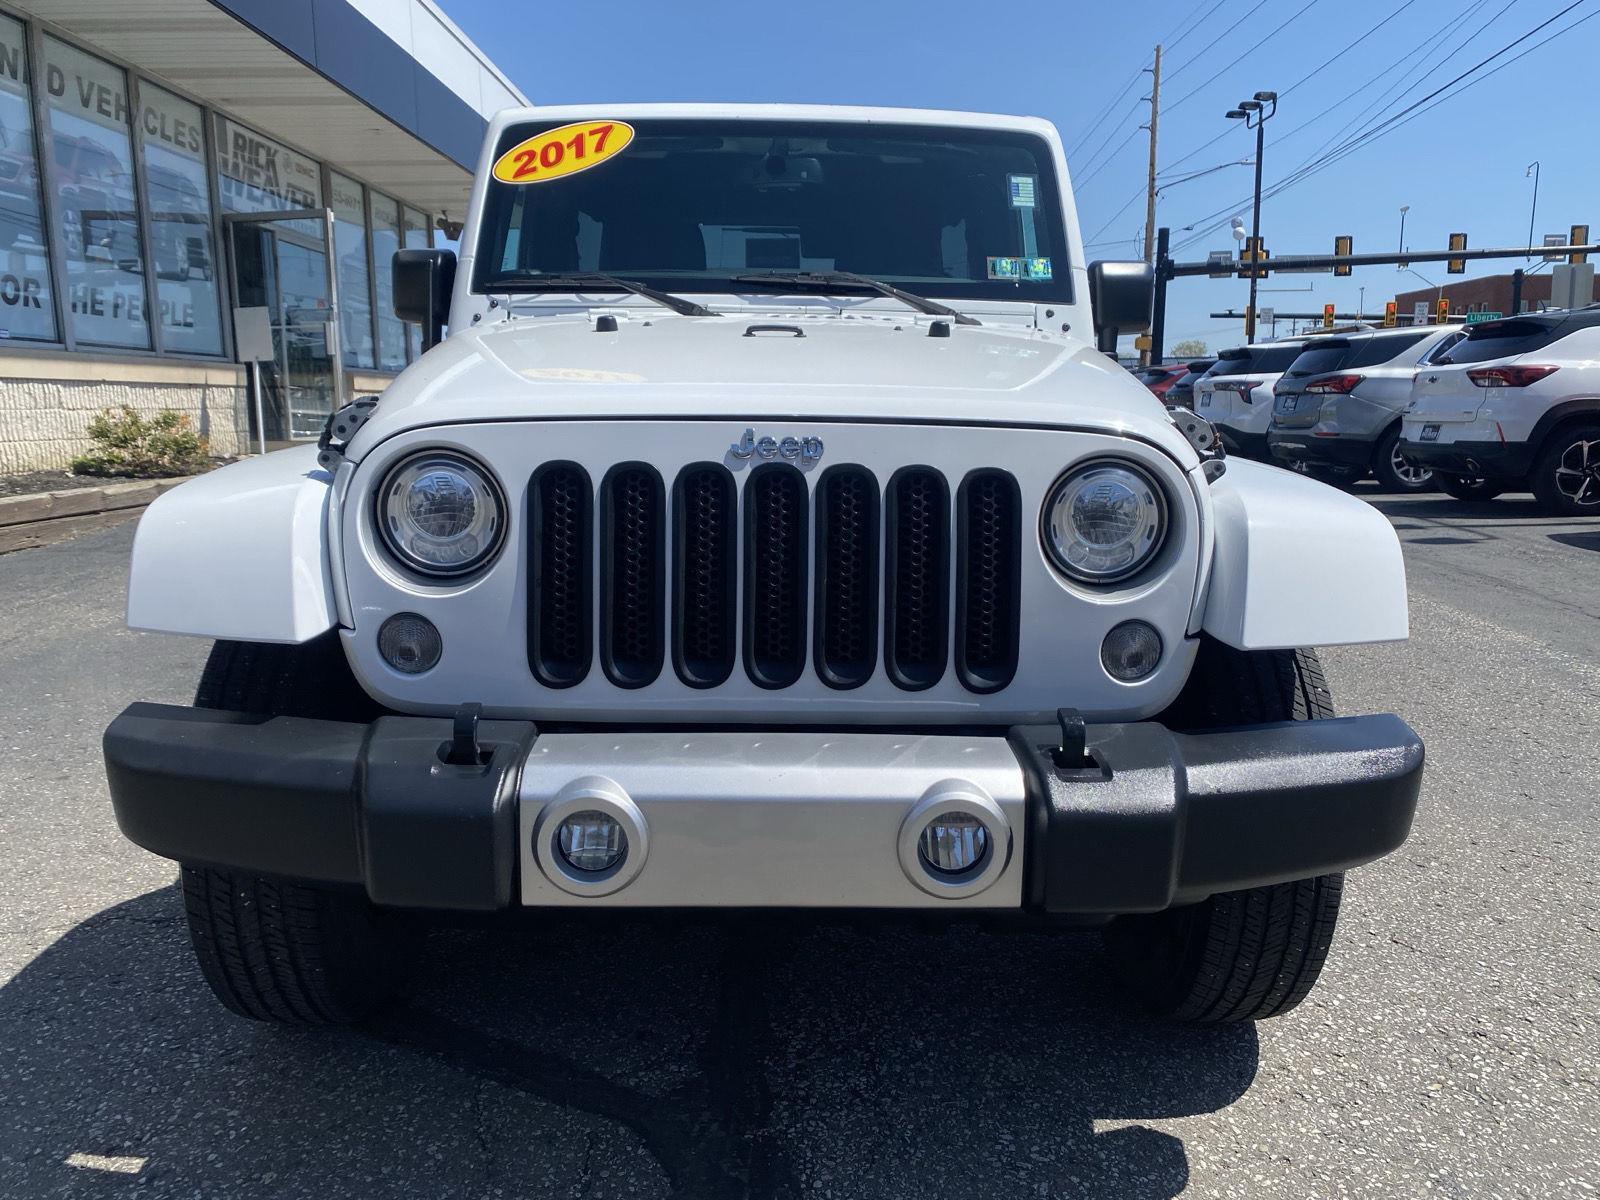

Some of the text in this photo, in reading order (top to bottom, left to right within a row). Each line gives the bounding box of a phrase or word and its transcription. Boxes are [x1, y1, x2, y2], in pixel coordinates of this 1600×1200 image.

[76, 75, 200, 153] VEHCLES
[232, 130, 279, 187] RICK
[512, 123, 614, 179] 2017
[1470, 313, 1499, 322] Liberty
[730, 428, 824, 465] Jeep
